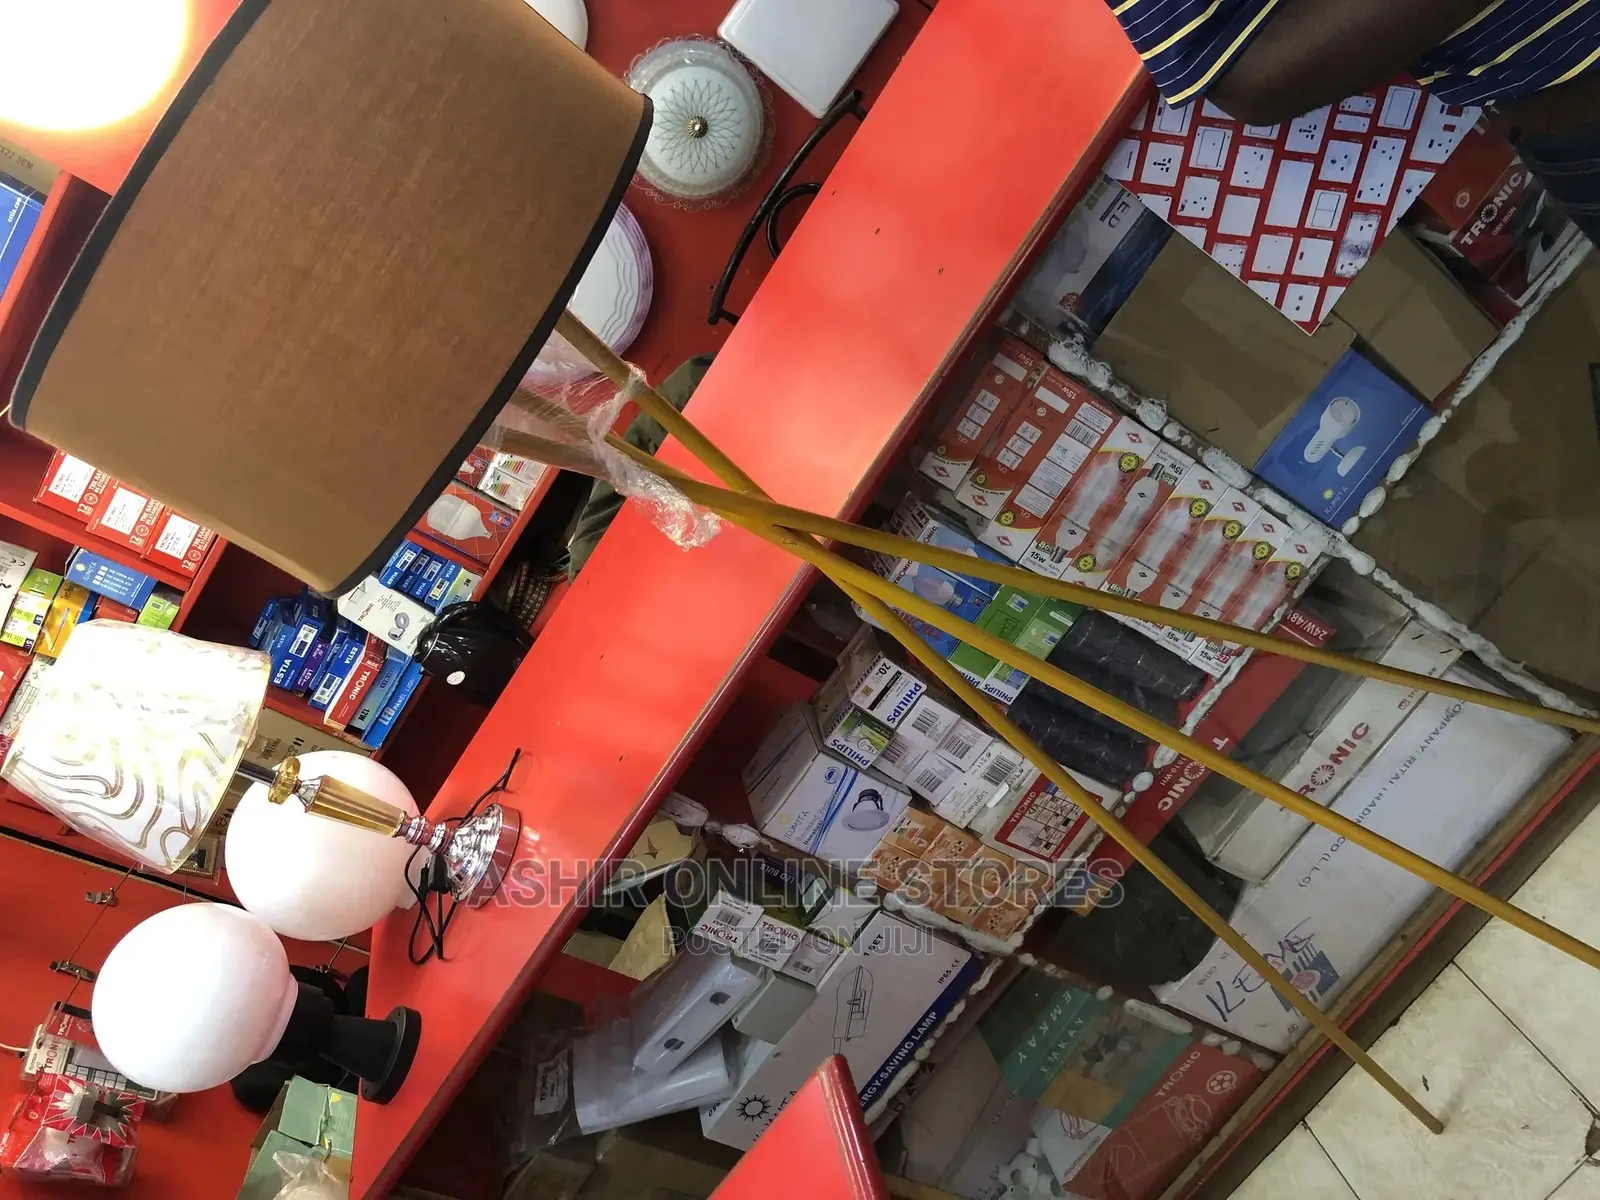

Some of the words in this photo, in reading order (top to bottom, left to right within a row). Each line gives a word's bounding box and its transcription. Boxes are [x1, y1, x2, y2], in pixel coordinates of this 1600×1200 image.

[1108, 193, 1131, 228] ED
[1460, 172, 1523, 246] TRONIC
[1491, 221, 1504, 237] DRY
[1503, 206, 1517, 224] IRON
[77, 503, 88, 515] 12
[1019, 509, 1030, 519] CFL
[129, 534, 140, 546] 12
[923, 525, 938, 544] ONIC
[181, 559, 192, 571] 12
[894, 560, 913, 585] TRONIC
[387, 571, 399, 585] ESTIA
[416, 582, 427, 596] ESTIA
[358, 602, 375, 622] TRONIC
[344, 647, 359, 664] ESTIA
[274, 659, 292, 685] ESTIA
[349, 670, 371, 700] TRONIC
[984, 683, 1014, 703] PHILIPS
[378, 706, 396, 726] LED
[394, 693, 408, 711] PANEL
[886, 682, 923, 724] PHILIPS
[358, 708, 371, 722] 12W
[831, 739, 870, 767] PHILIPS
[1288, 722, 1370, 804] RONIC
[1157, 737, 1230, 811] TONIC
[1009, 791, 1037, 823] TRONIC
[784, 810, 809, 839] ILUMITA
[760, 863, 780, 877] BULB
[780, 871, 795, 884] LED
[700, 924, 738, 944] TRONIC
[762, 921, 798, 941] TRONIC
[868, 933, 884, 951] SET
[937, 970, 952, 984] IP65
[57, 1013, 71, 1036] TRONIC
[44, 1040, 60, 1070] TRONI
[860, 1041, 914, 1107] ERGY-SAVING
[911, 1011, 938, 1041] LAMP
[1155, 1051, 1201, 1097] TRONIC
